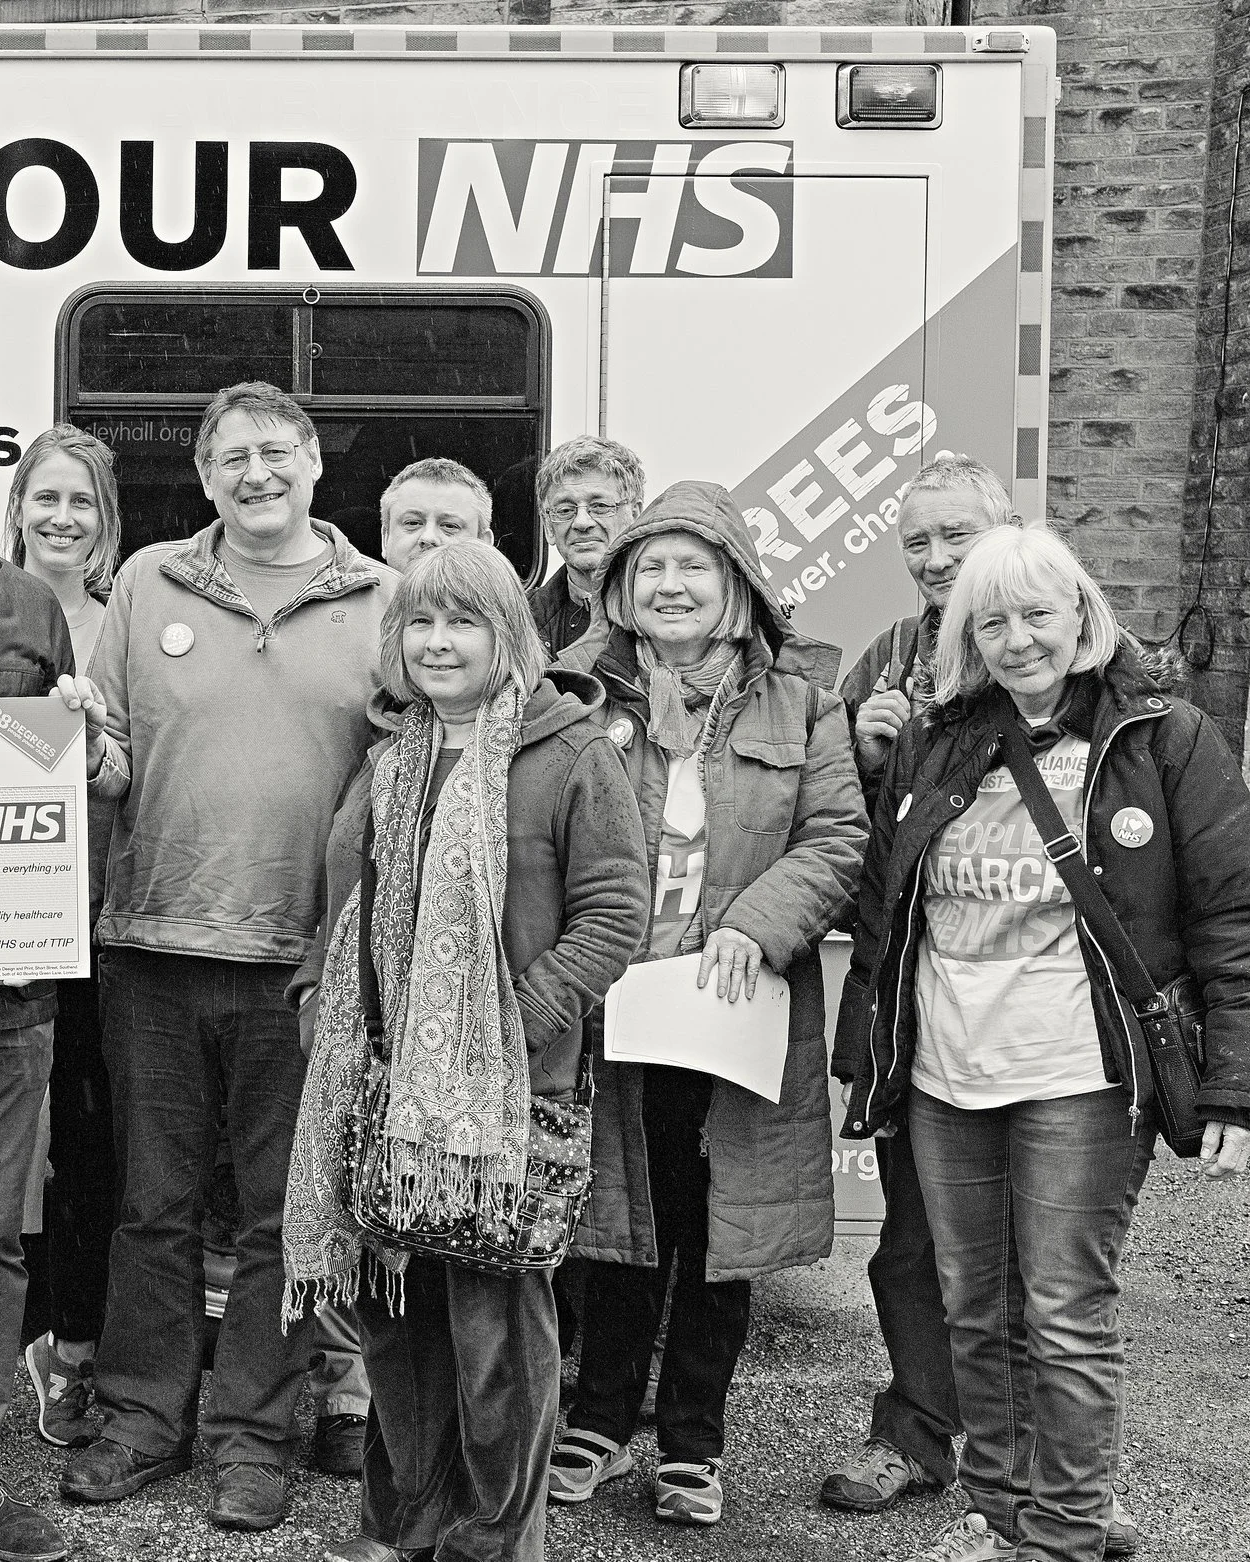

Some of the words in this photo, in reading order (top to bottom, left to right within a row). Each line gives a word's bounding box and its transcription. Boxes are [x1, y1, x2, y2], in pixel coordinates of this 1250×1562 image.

[417, 141, 792, 277] NHS
[741, 384, 938, 580] REES
[777, 551, 847, 608] wer.
[10, 719, 56, 758] DEGREES
[939, 821, 1043, 855] EOPLE
[1117, 829, 1141, 843] NHS
[2, 864, 52, 875] everything
[54, 864, 72, 875] you
[14, 910, 63, 920] healthcare
[19, 939, 35, 949] out
[37, 938, 48, 948] of
[50, 938, 74, 948] TTIP
